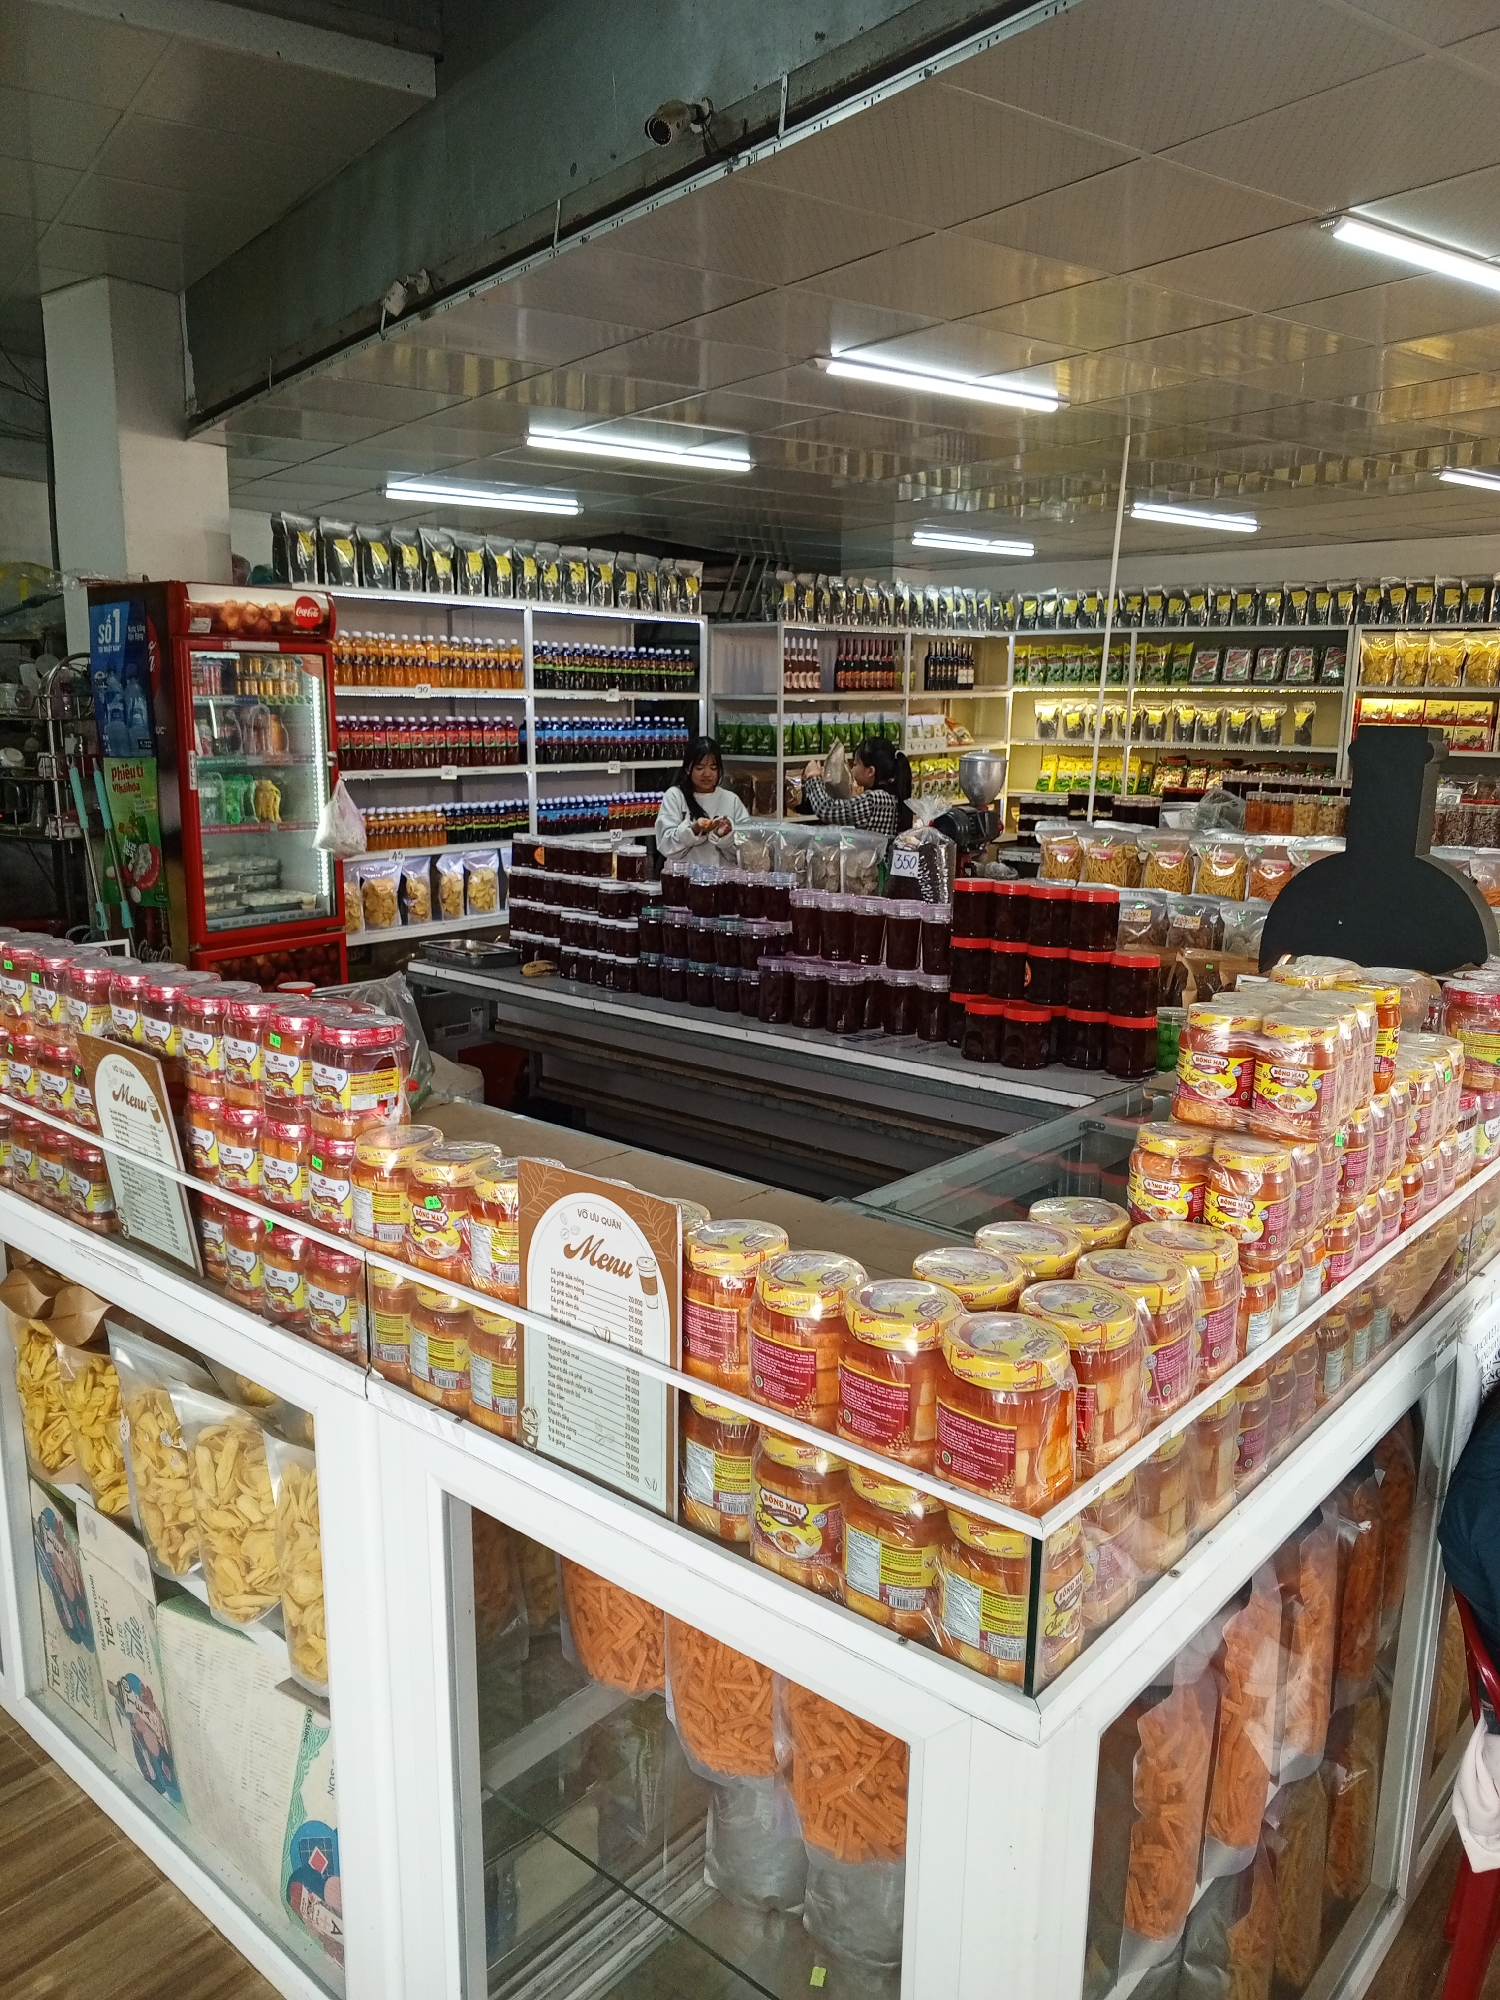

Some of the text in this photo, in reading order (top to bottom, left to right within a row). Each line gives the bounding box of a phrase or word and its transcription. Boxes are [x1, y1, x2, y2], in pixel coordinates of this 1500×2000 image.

[112, 609, 120, 643] 1
[894, 854, 917, 870] 350
[112, 1083, 148, 1113] Menu
[563, 1234, 633, 1279] Menu
[763, 1493, 784, 1509] BÔNG
[785, 1503, 802, 1516] MAI
